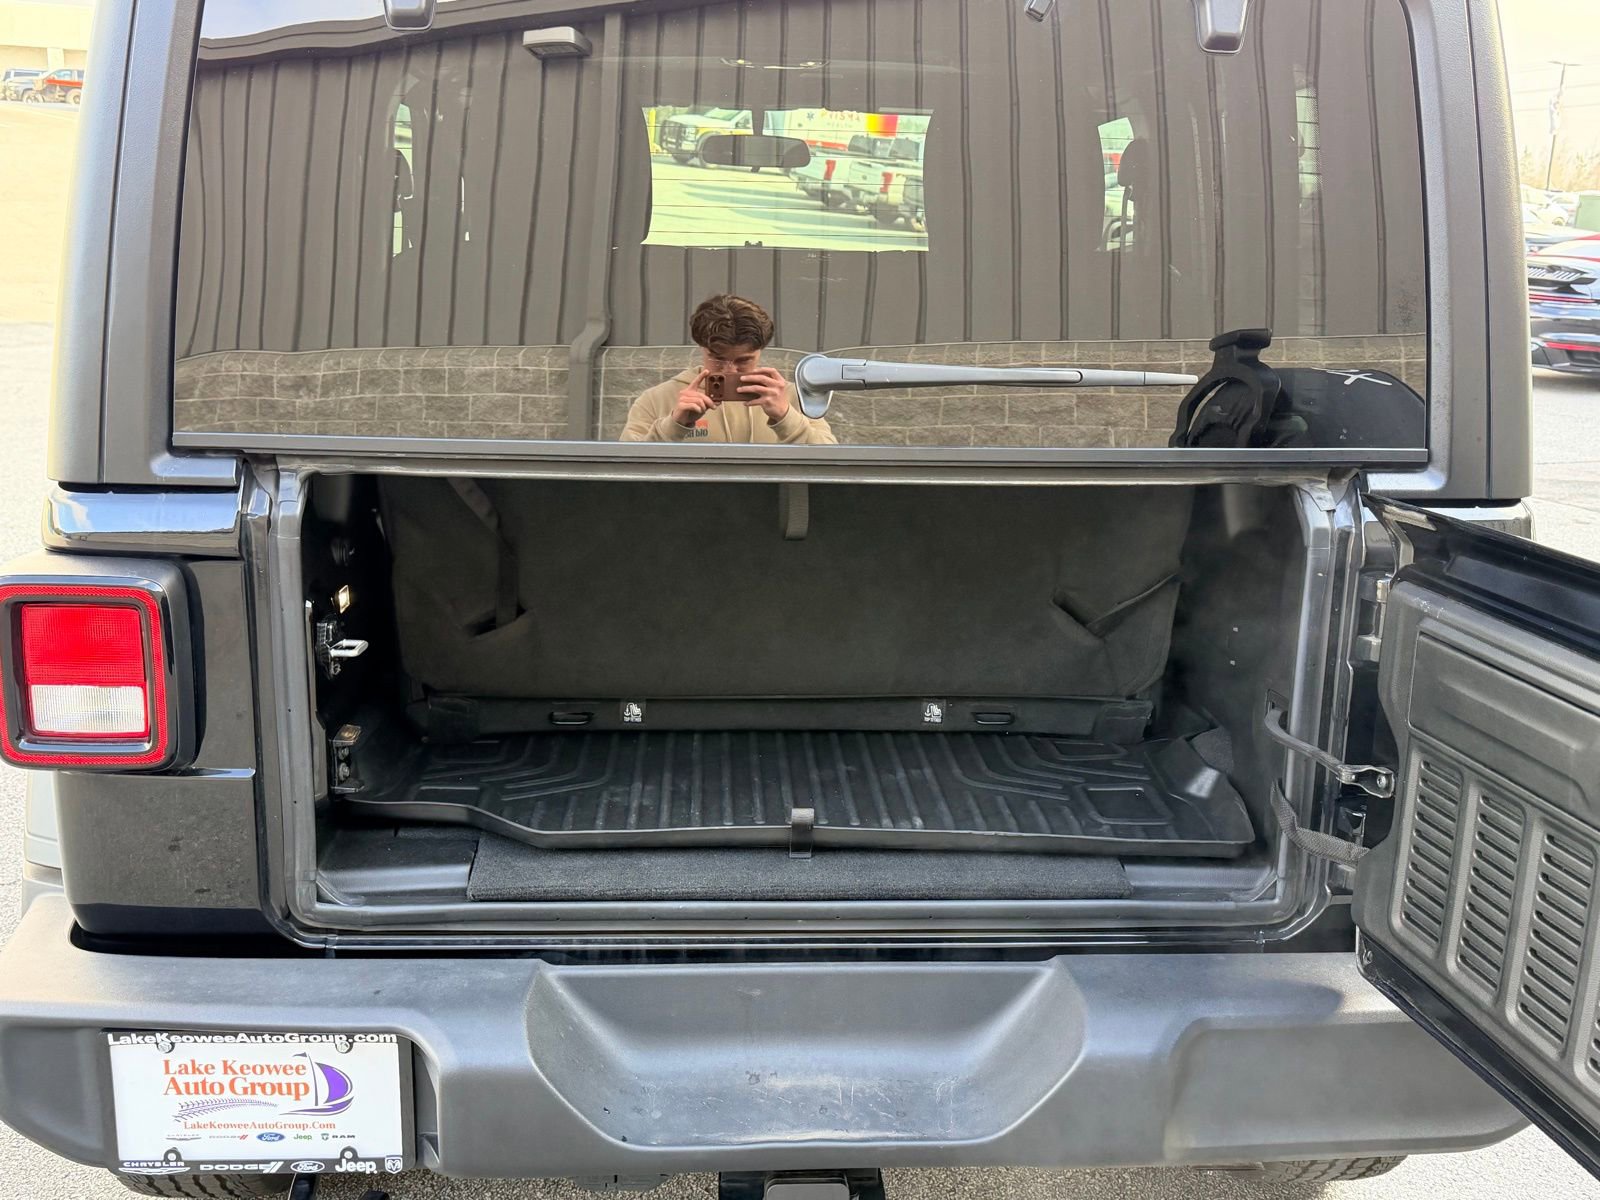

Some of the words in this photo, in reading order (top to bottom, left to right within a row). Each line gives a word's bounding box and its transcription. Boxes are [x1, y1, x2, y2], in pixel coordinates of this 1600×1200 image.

[107, 1032, 398, 1046] LakeKeoweeAutoGroup.com
[163, 1059, 216, 1076] Lake
[222, 1059, 307, 1076] Keowee
[163, 1076, 225, 1096] Auto
[229, 1076, 310, 1101] Group
[183, 1121, 336, 1131] LakeKeoweeAutoGroup.Com
[260, 1133, 281, 1142] Ford
[293, 1133, 313, 1141] Jeep
[296, 1162, 320, 1172] Ford
